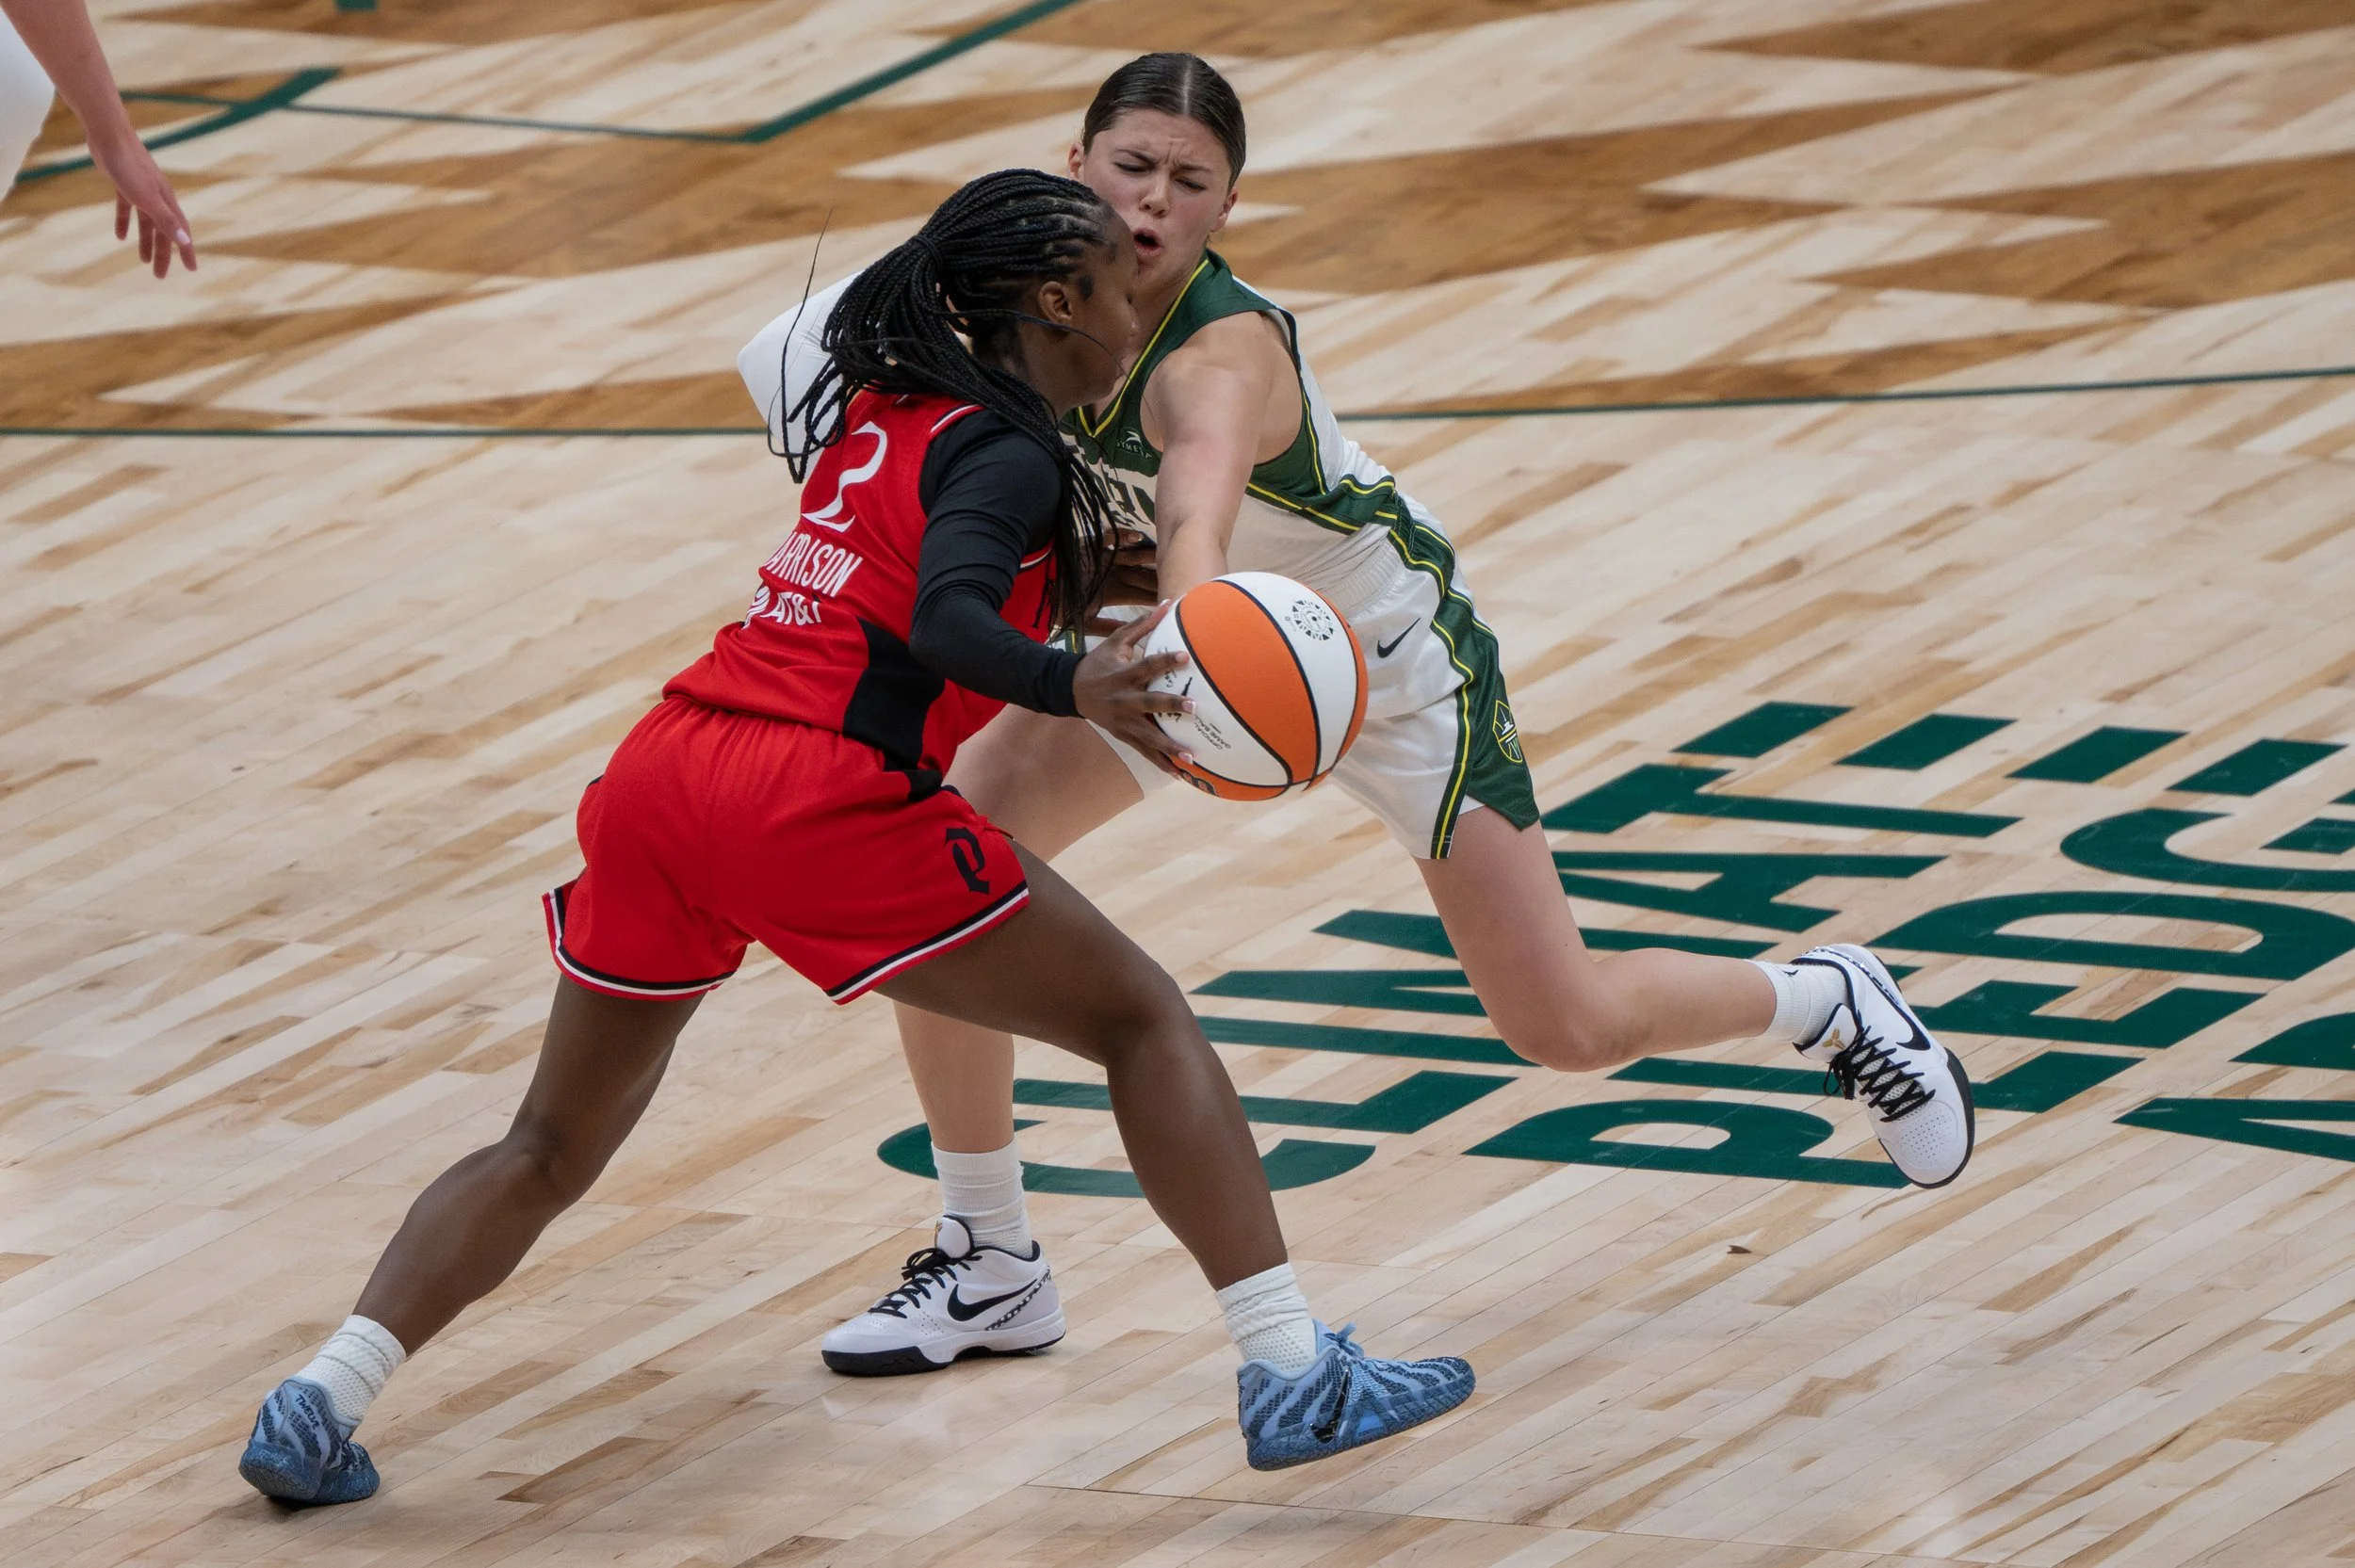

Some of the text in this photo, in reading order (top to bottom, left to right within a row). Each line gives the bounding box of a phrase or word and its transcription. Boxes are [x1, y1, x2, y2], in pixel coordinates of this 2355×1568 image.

[1116, 440, 1153, 460] SYMEA
[801, 421, 887, 532] 2
[764, 531, 864, 598] ARRISON
[760, 591, 822, 626] AT&T
[296, 1394, 320, 1430] TWELVE
